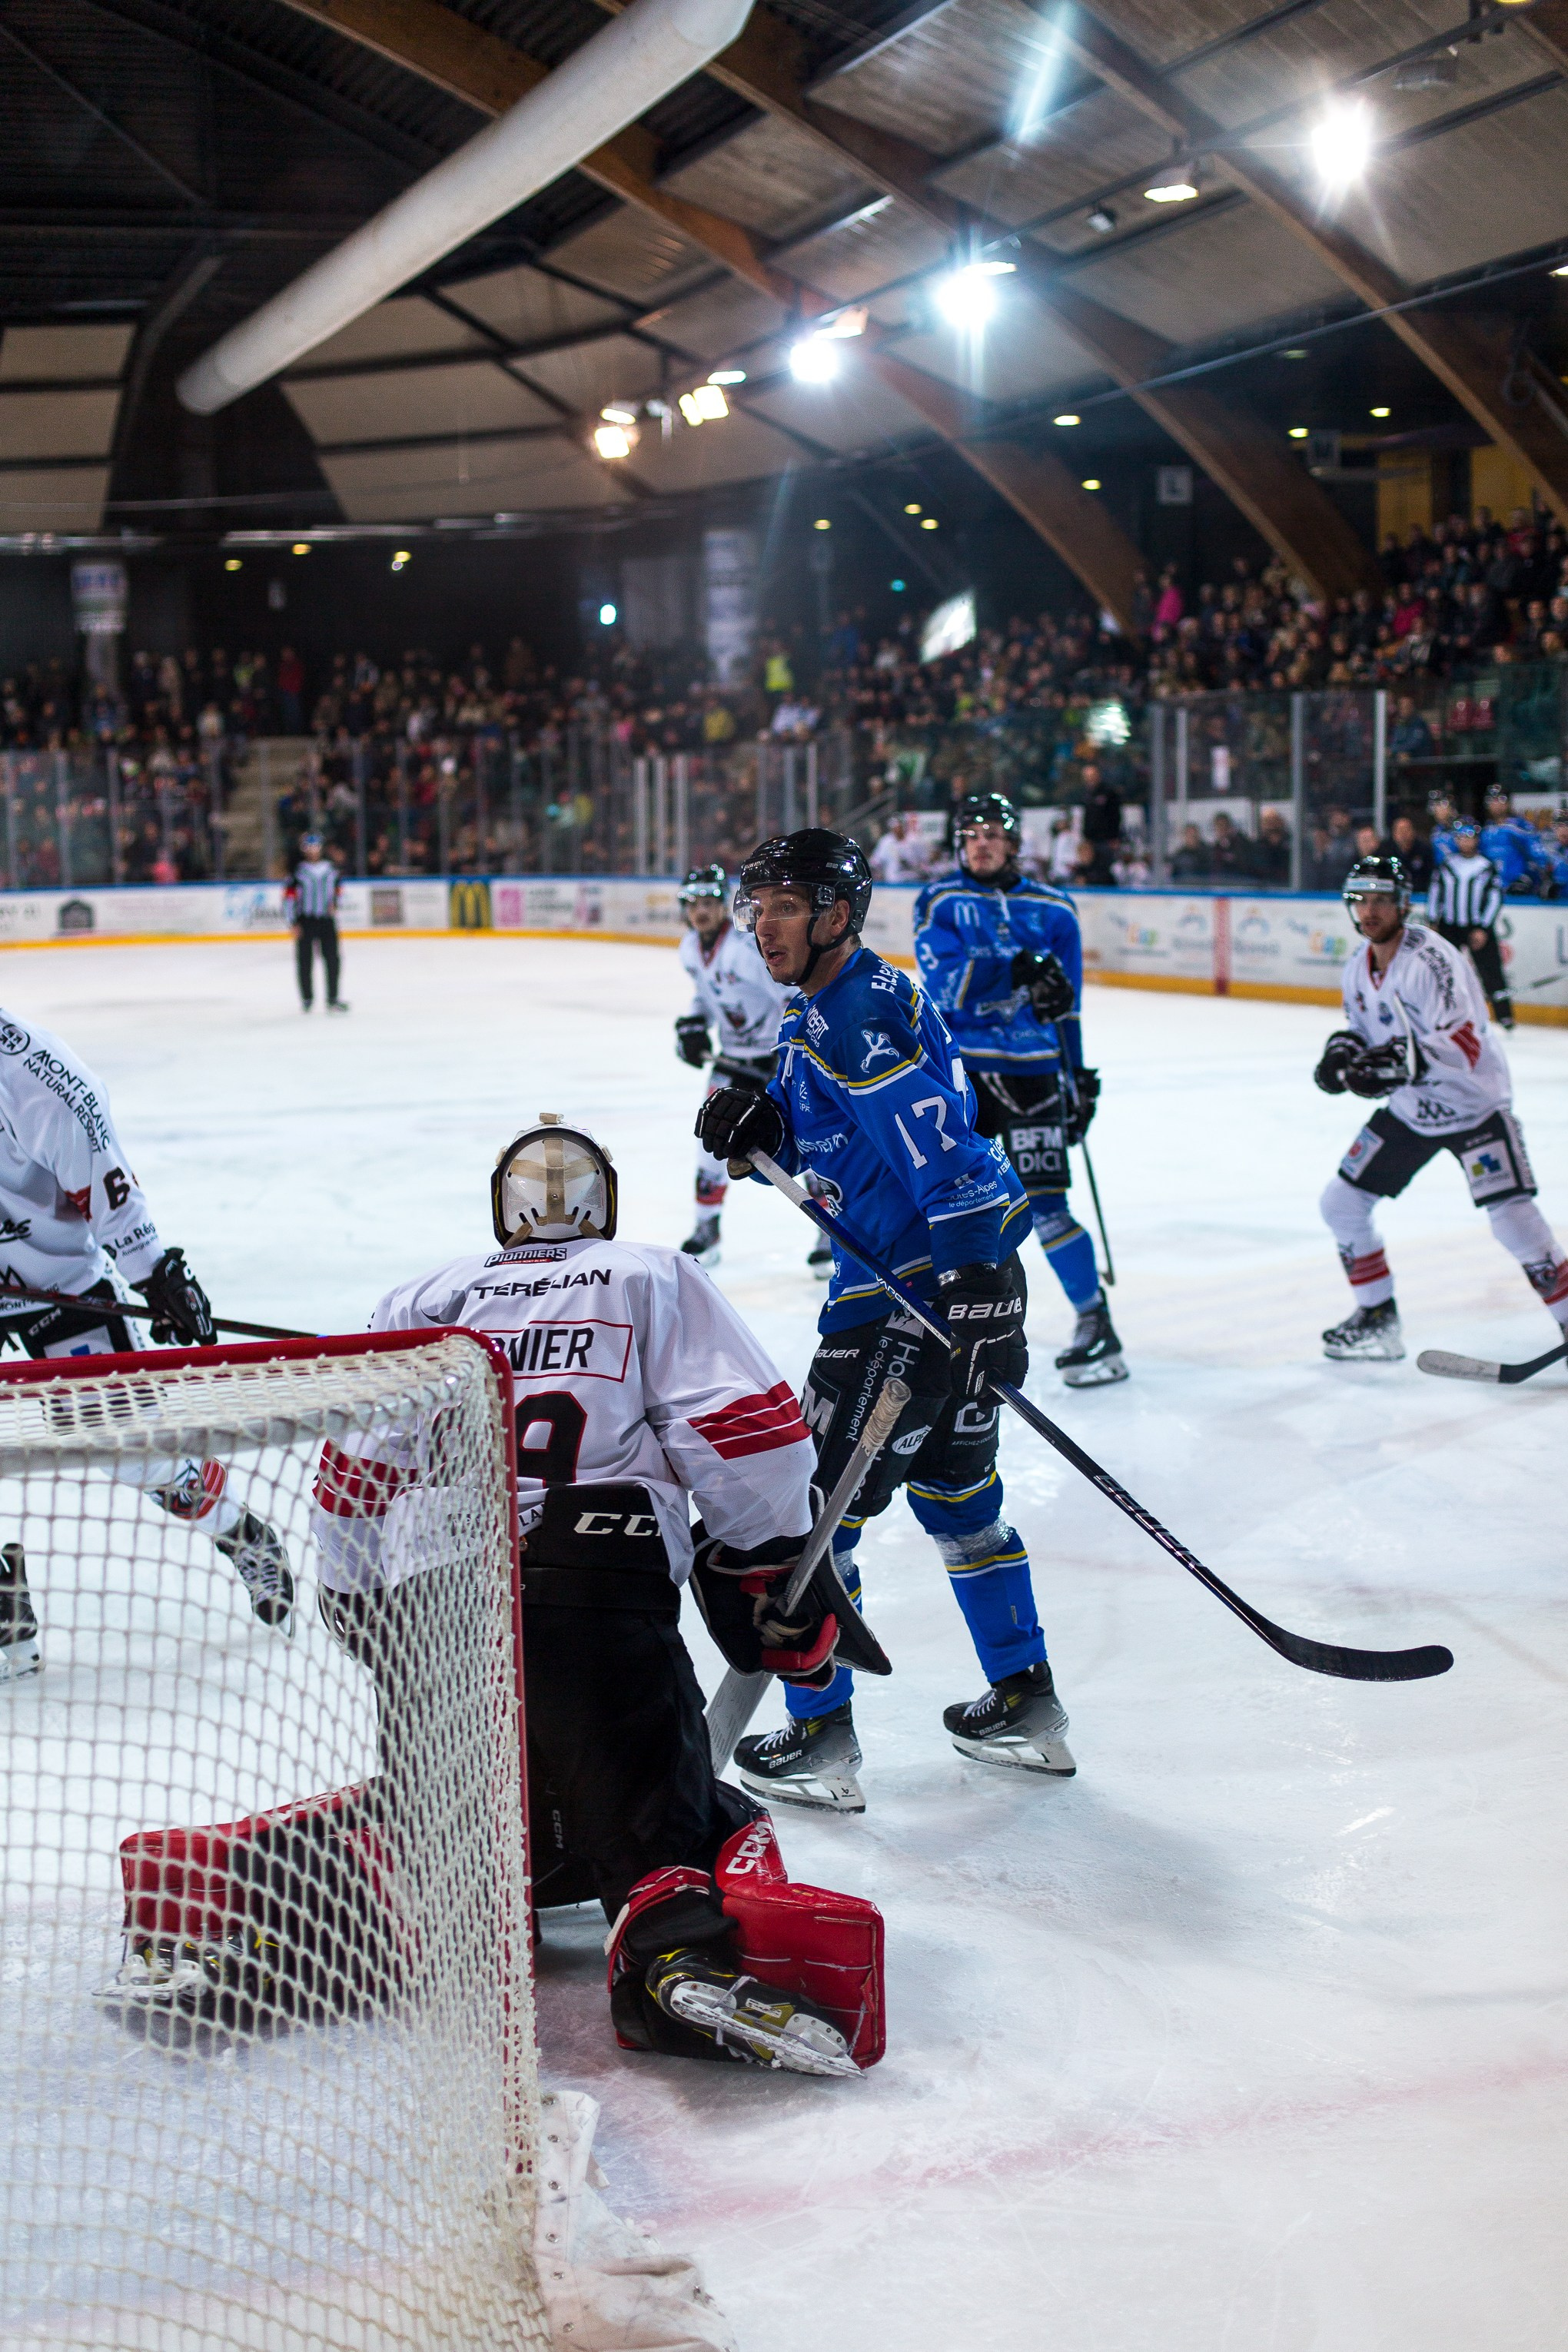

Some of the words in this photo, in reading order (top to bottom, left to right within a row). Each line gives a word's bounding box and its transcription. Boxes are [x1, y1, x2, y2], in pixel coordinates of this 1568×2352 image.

[23, 1058, 75, 1109] NATURAL
[74, 1104, 101, 1154] RESORT
[32, 1049, 111, 1151] MONT-BLANC
[894, 1095, 958, 1170] 17
[1011, 1126, 1063, 1151] BFM
[1018, 1151, 1062, 1174] DICI
[955, 1192, 995, 1208] département
[115, 1237, 133, 1249] La
[483, 1248, 567, 1267] PIONNIERS
[948, 1296, 1022, 1321] BAUE
[879, 1336, 893, 1348] le
[845, 1350, 884, 1442] département
[573, 1512, 662, 1536] CC
[978, 1720, 1007, 1736] BAUER
[769, 1749, 802, 1769] BAUER
[553, 1809, 563, 1849] CCM
[725, 1821, 774, 1875] CCM
